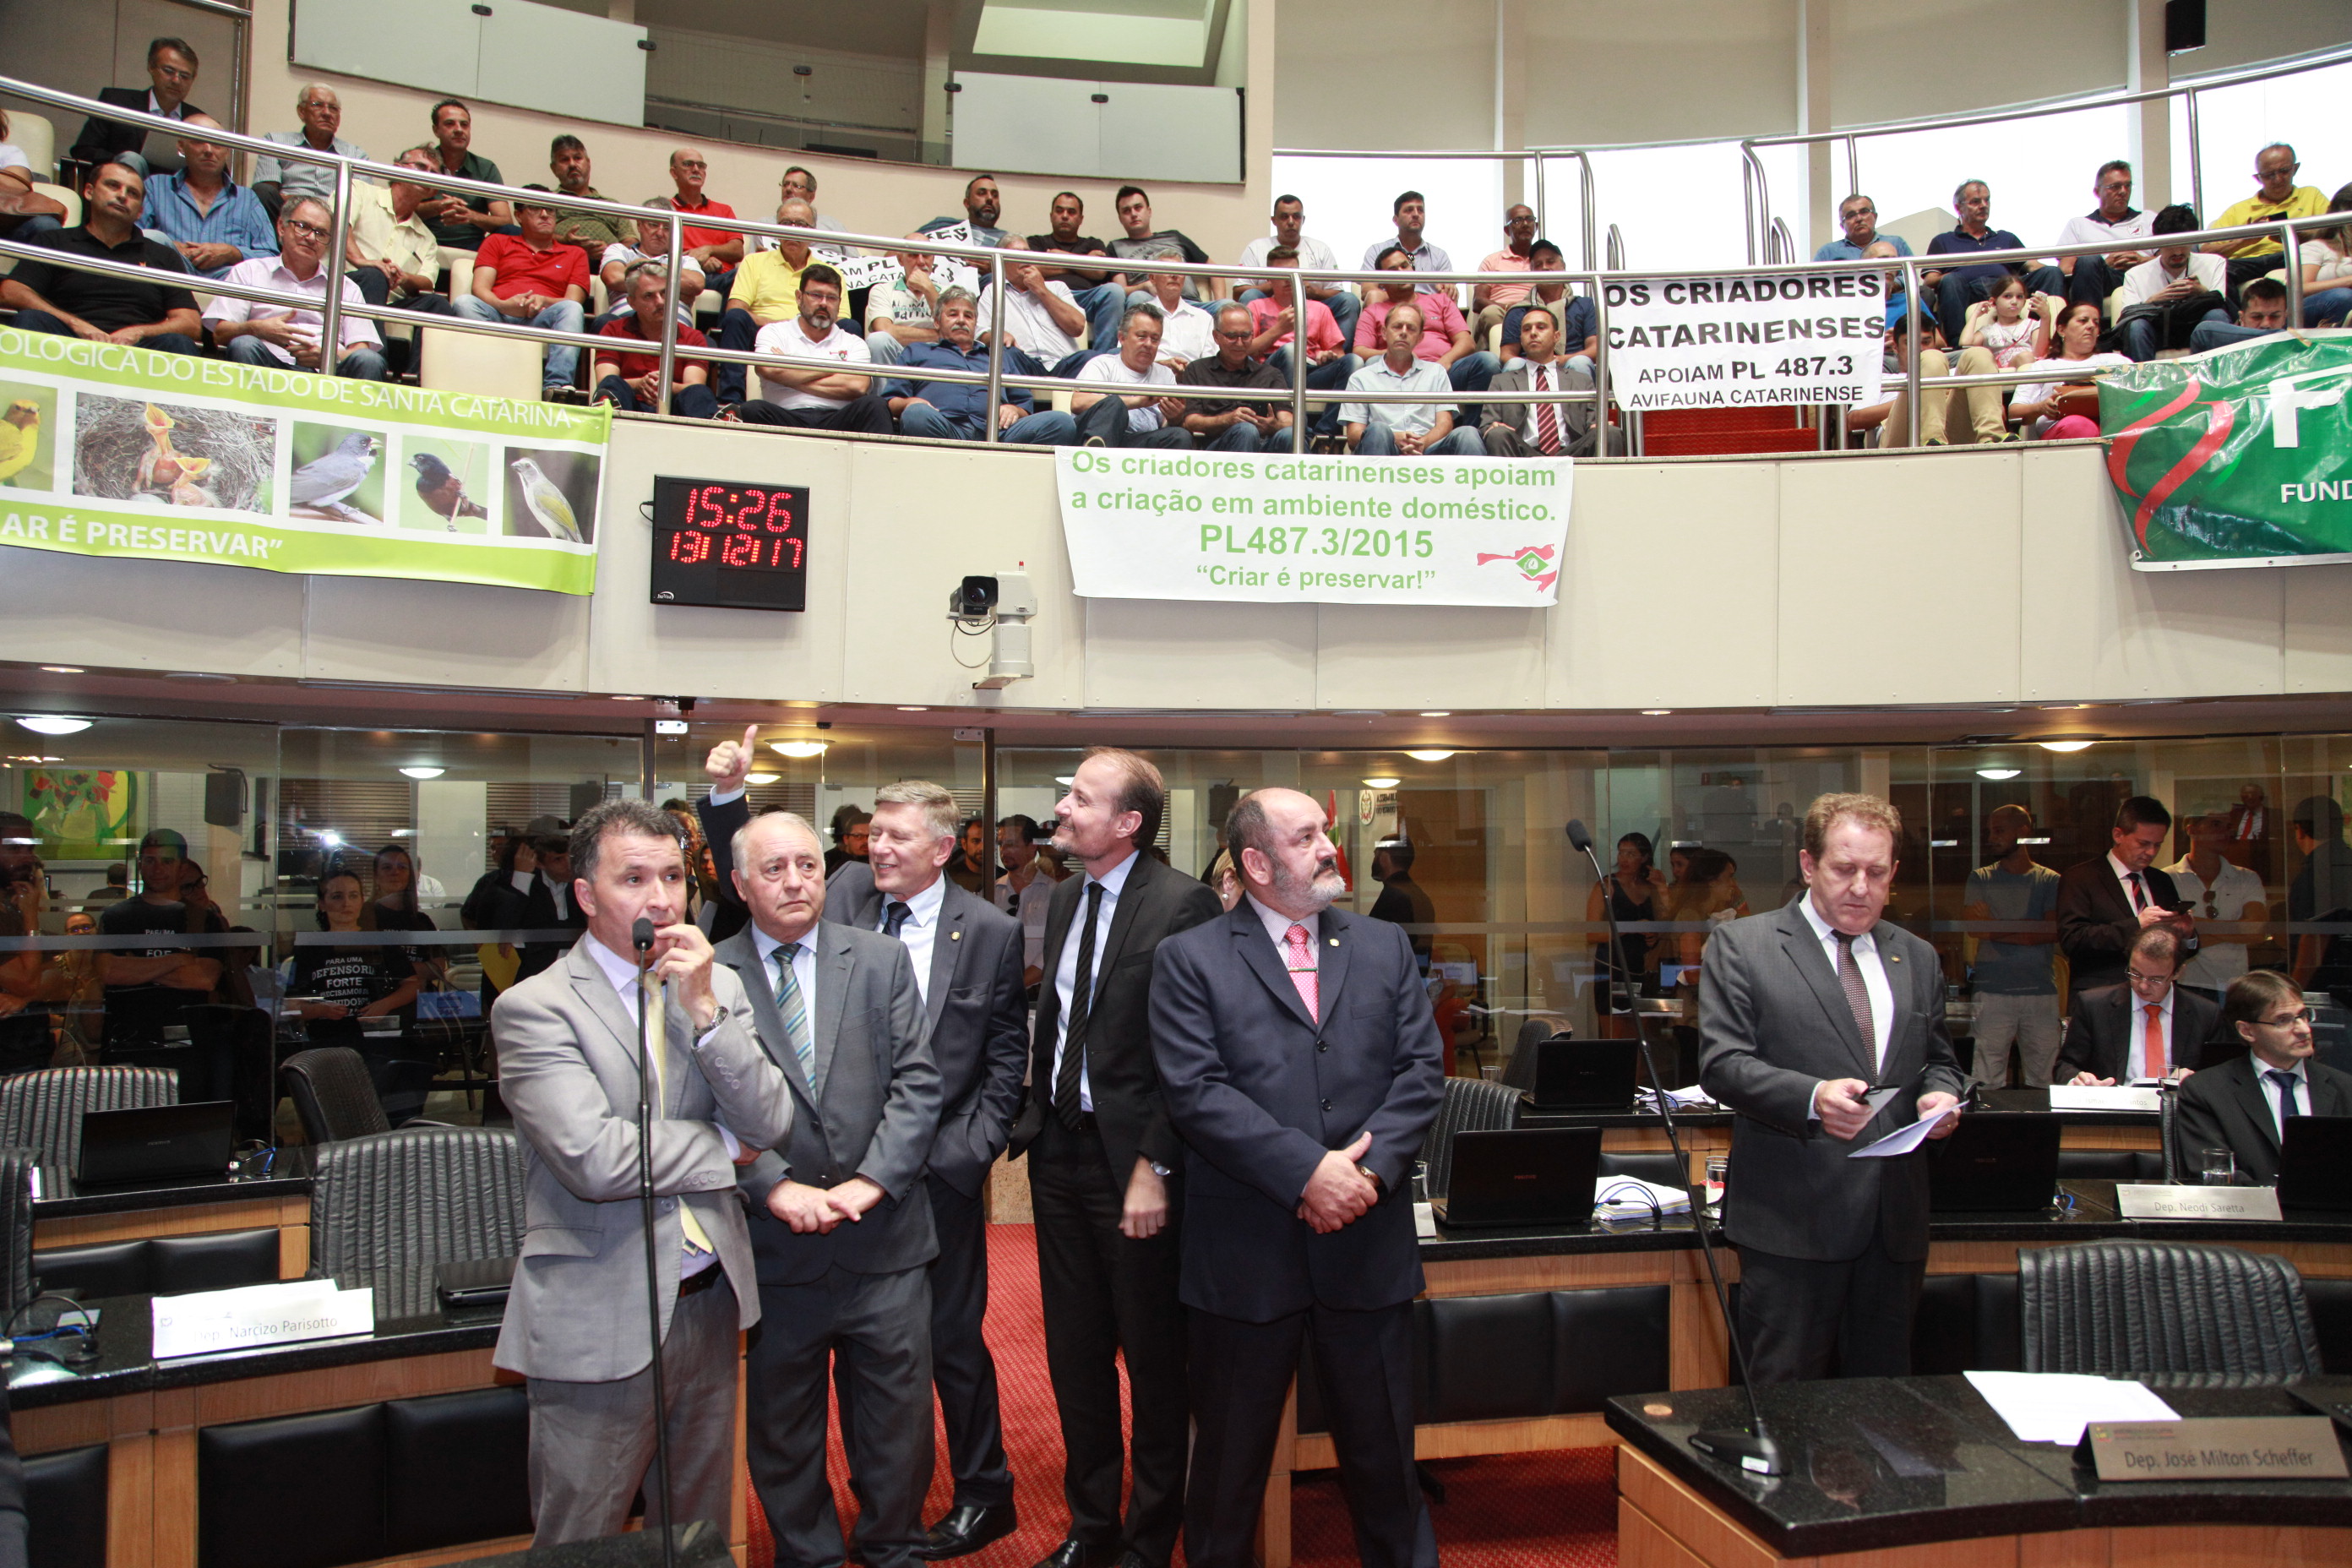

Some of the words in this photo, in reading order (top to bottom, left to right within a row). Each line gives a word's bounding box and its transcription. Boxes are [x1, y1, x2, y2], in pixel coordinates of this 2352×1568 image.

[1606, 284, 1650, 307] OS
[1663, 274, 1881, 305] CRIADORES
[1609, 316, 1884, 350] CATARINENSES
[1639, 364, 1723, 384] APOIAM
[1732, 361, 1766, 379] PL
[1775, 355, 1854, 377] 487.3
[149, 354, 195, 380] DO
[203, 361, 313, 396] ESTADO
[318, 379, 354, 404] DE
[360, 385, 444, 415] SANTA
[450, 397, 571, 428] CATARINA
[1630, 390, 1724, 408] AVIFAUNA
[1730, 385, 1864, 405] CATARINENSE
[1072, 450, 1111, 474] Os
[1121, 453, 1255, 480] criadores
[1264, 462, 1445, 486] catarinenses
[1455, 464, 1555, 490] apoiam
[685, 485, 792, 533] 15:26
[1071, 492, 1087, 509] a
[1097, 487, 1202, 516] criação
[1211, 497, 1254, 514] em
[1263, 493, 1392, 519] ambiente
[1402, 497, 1556, 521] doméstico.
[59, 514, 77, 543] É
[1200, 524, 1434, 558] PL487.3/2015
[1277, 568, 1291, 587] é
[326, 977, 363, 988] FORTE
[2153, 1201, 2177, 1212] Dep.
[2179, 1202, 2208, 1212] Neodi
[2211, 1203, 2246, 1213] Saretta
[229, 1324, 278, 1339] Narcizo
[281, 1318, 338, 1332] Parisotto
[2124, 1451, 2159, 1471] Dep.
[2164, 1450, 2197, 1467] José
[2201, 1450, 2250, 1467] Milton
[2255, 1449, 2314, 1467] Scheffer
